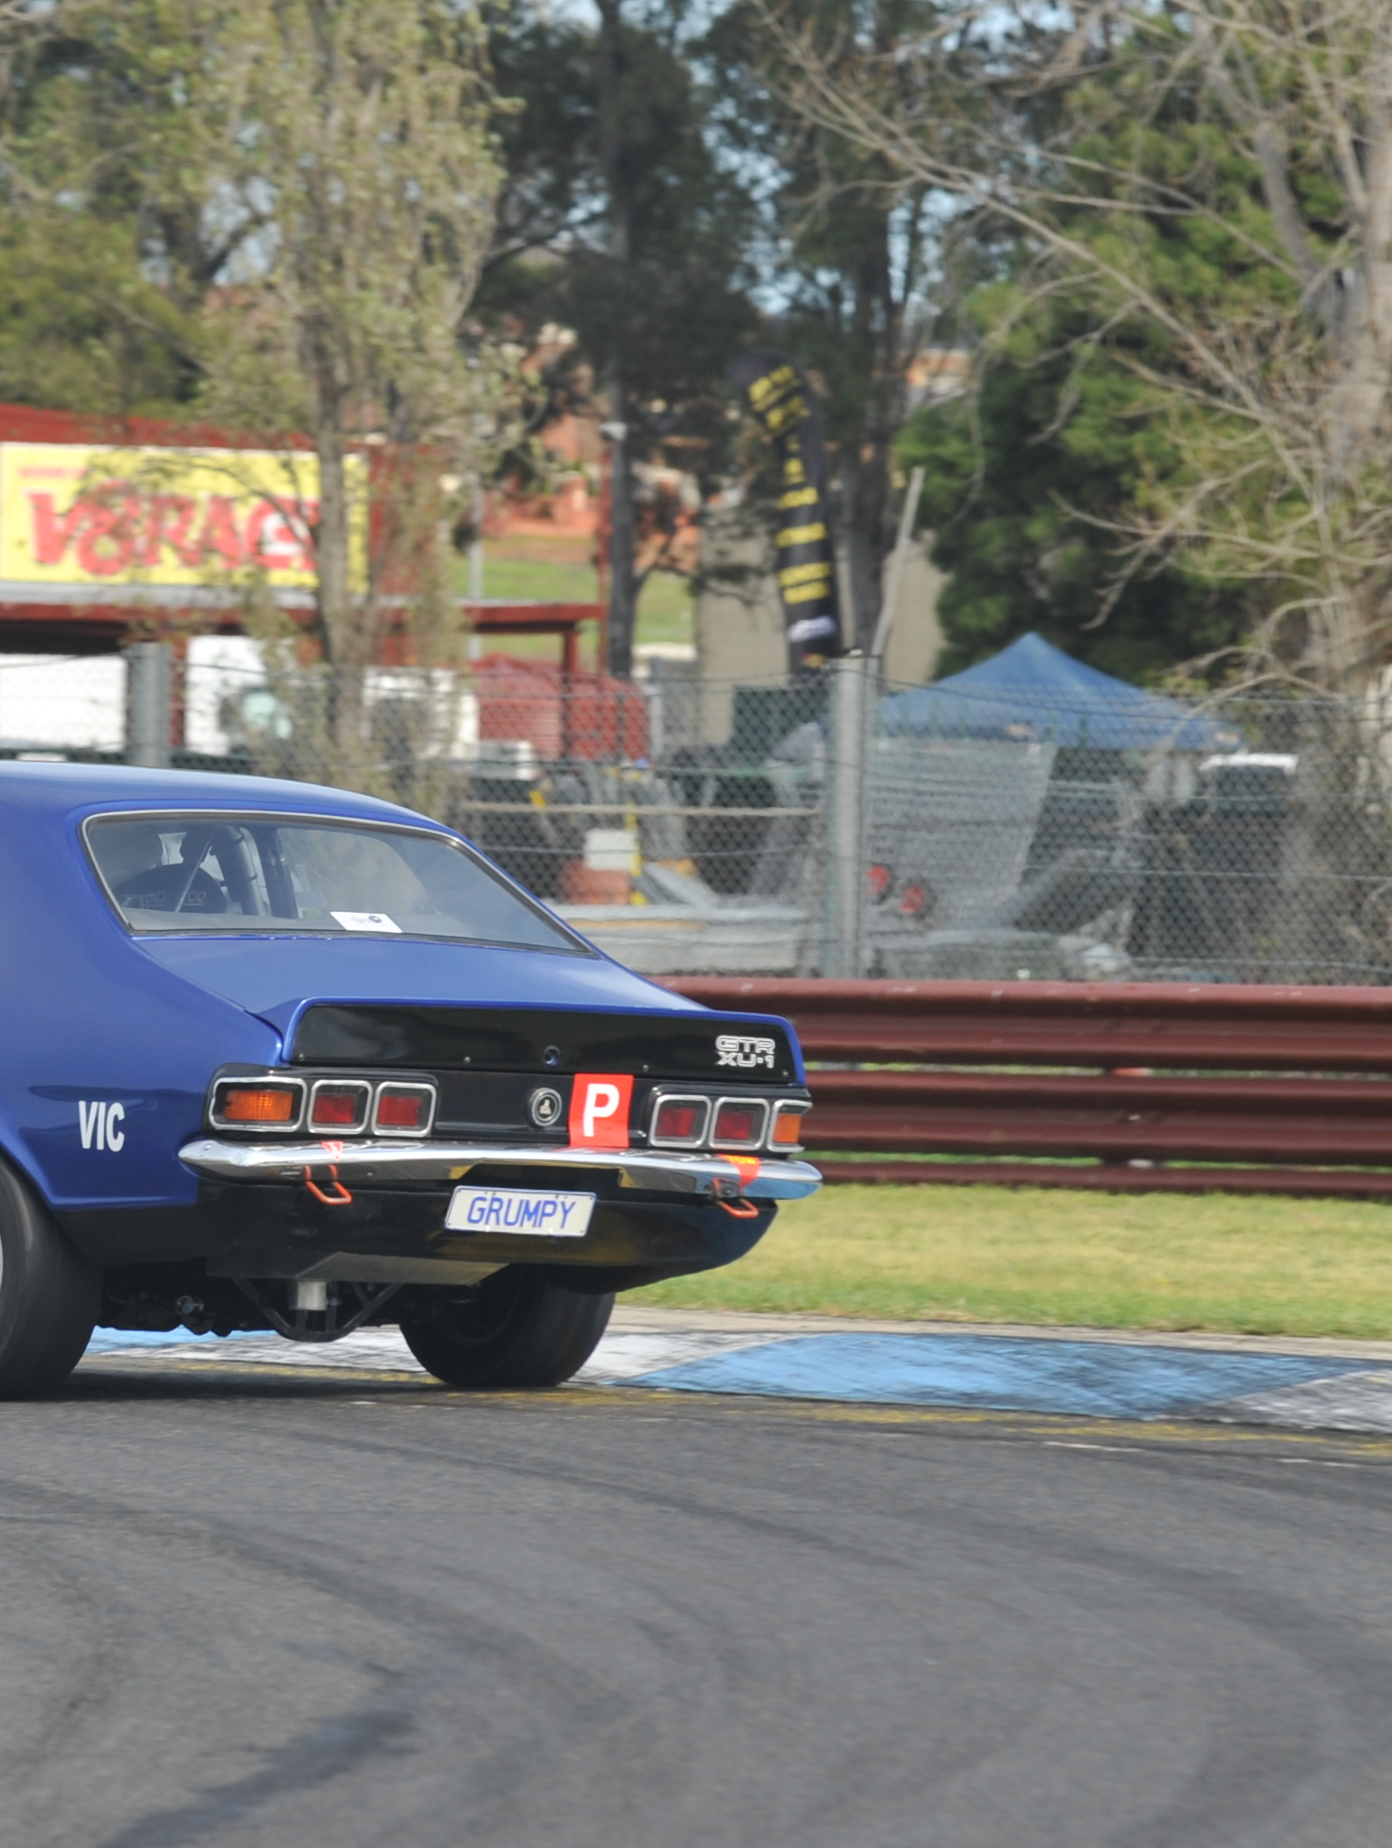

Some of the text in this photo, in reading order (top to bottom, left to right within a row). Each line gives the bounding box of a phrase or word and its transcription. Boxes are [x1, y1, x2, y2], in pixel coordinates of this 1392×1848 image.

[715, 1034, 776, 1054] GTR
[78, 1100, 126, 1152] VIC
[582, 1083, 620, 1138] P
[467, 1196, 577, 1230] GRUMPY
